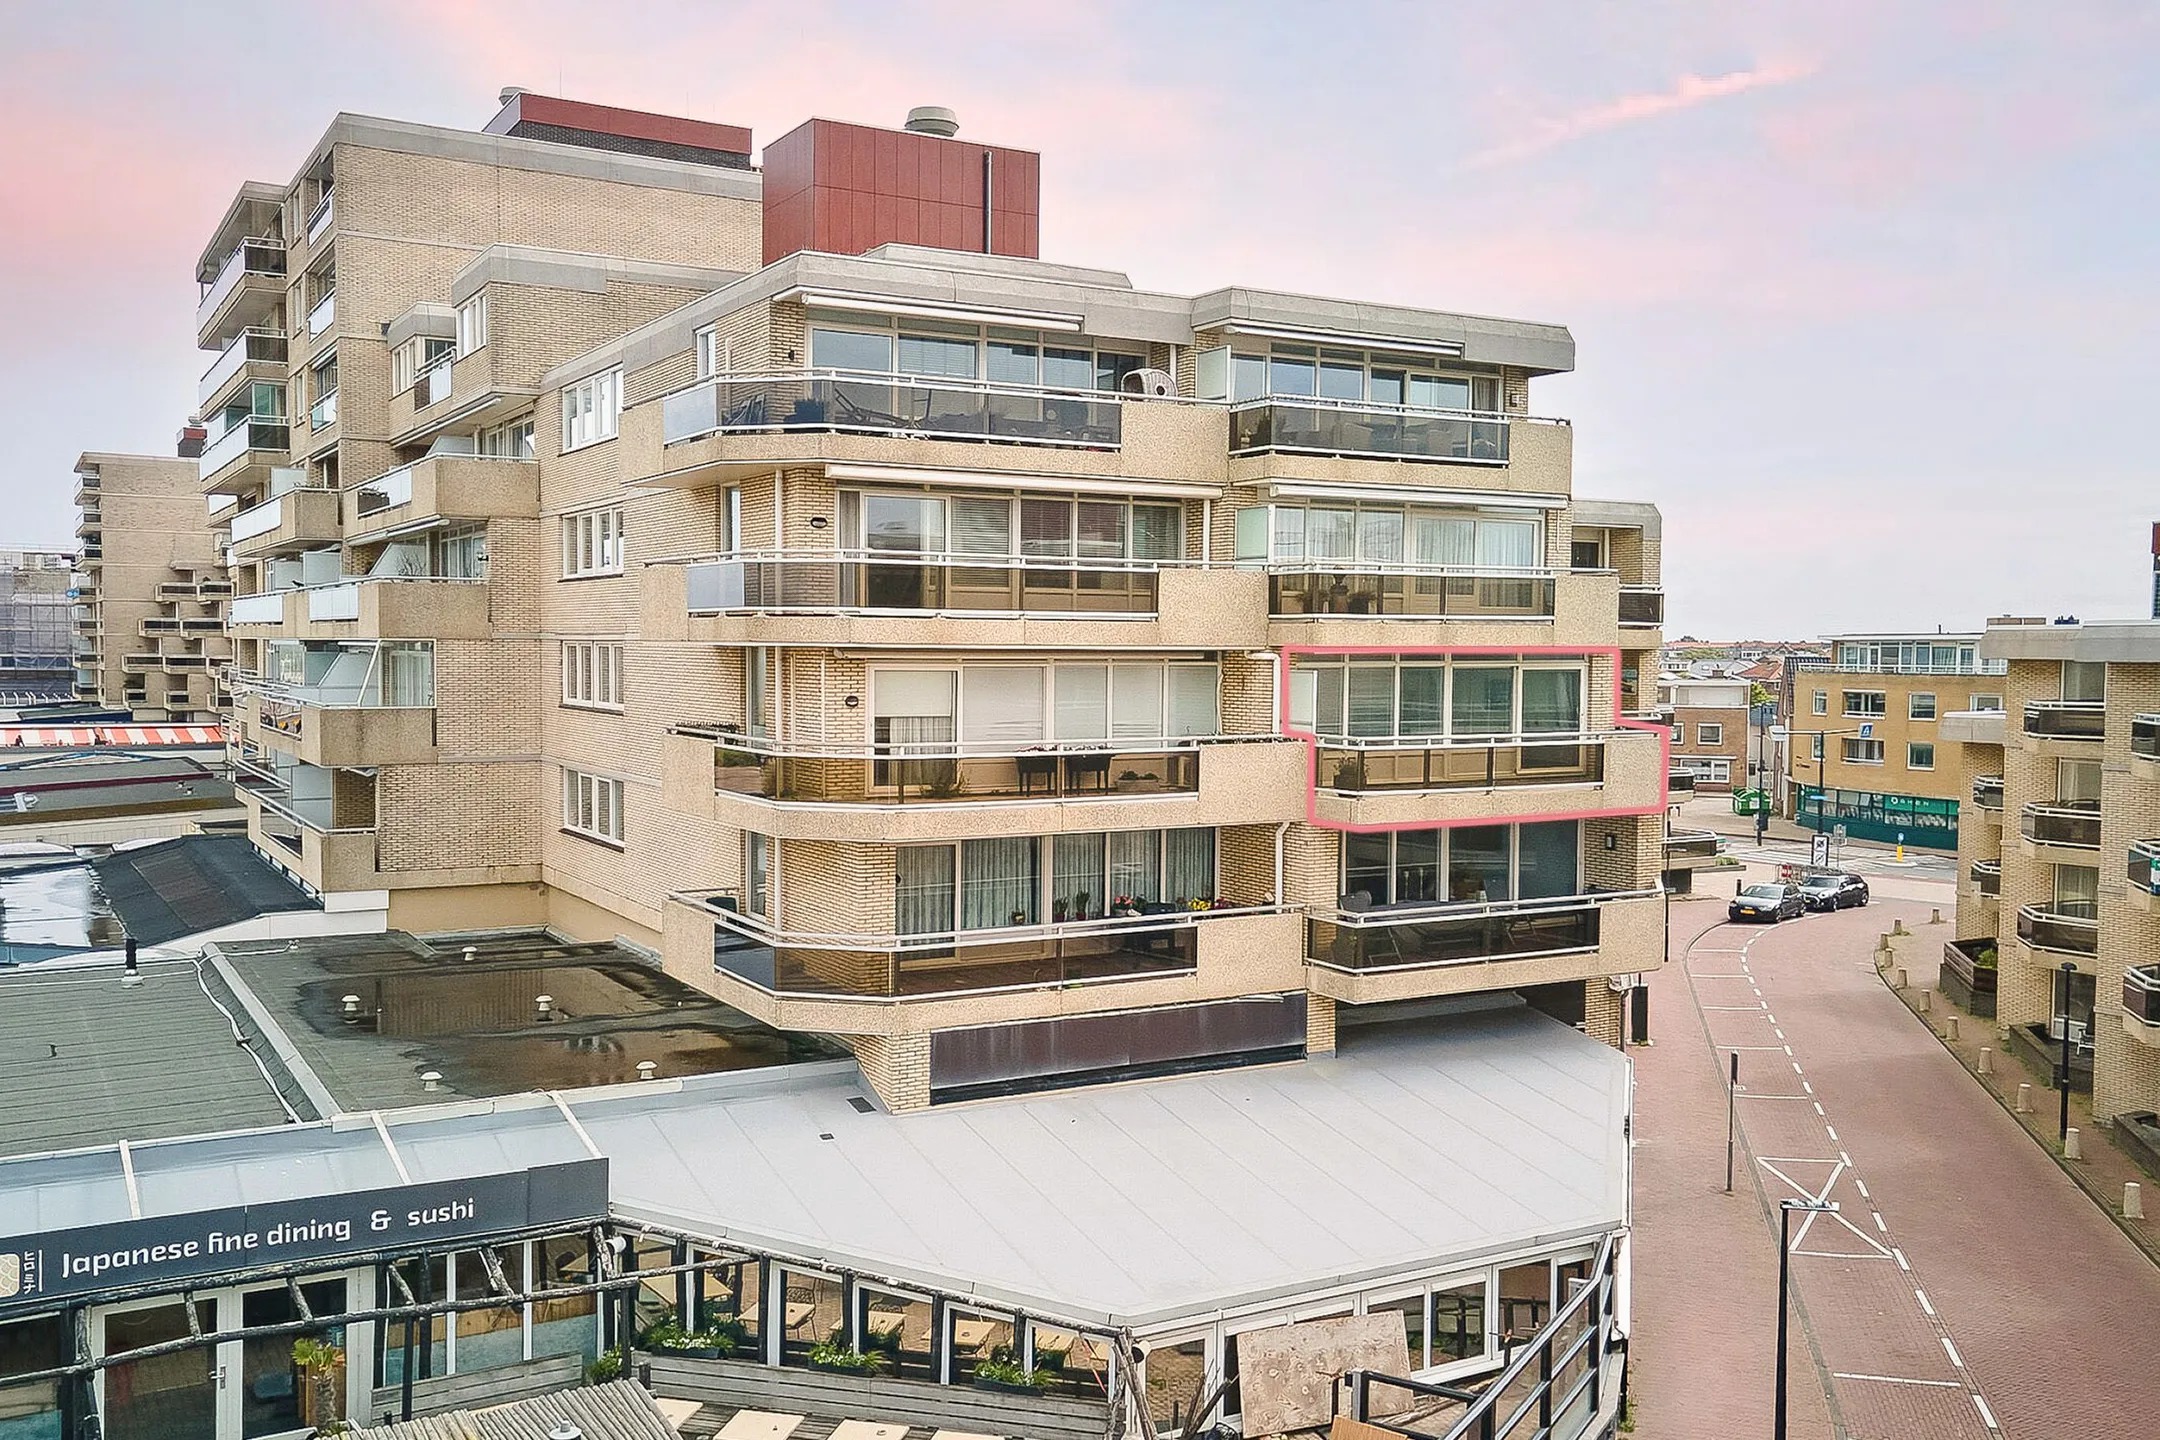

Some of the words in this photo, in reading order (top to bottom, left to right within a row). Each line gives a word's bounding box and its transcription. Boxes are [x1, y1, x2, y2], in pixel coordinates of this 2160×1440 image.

[62, 1240, 199, 1278] Japanese
[208, 1232, 259, 1254] fine
[266, 1218, 351, 1246] dining
[370, 1209, 392, 1231] &
[407, 1197, 475, 1227] sushi
